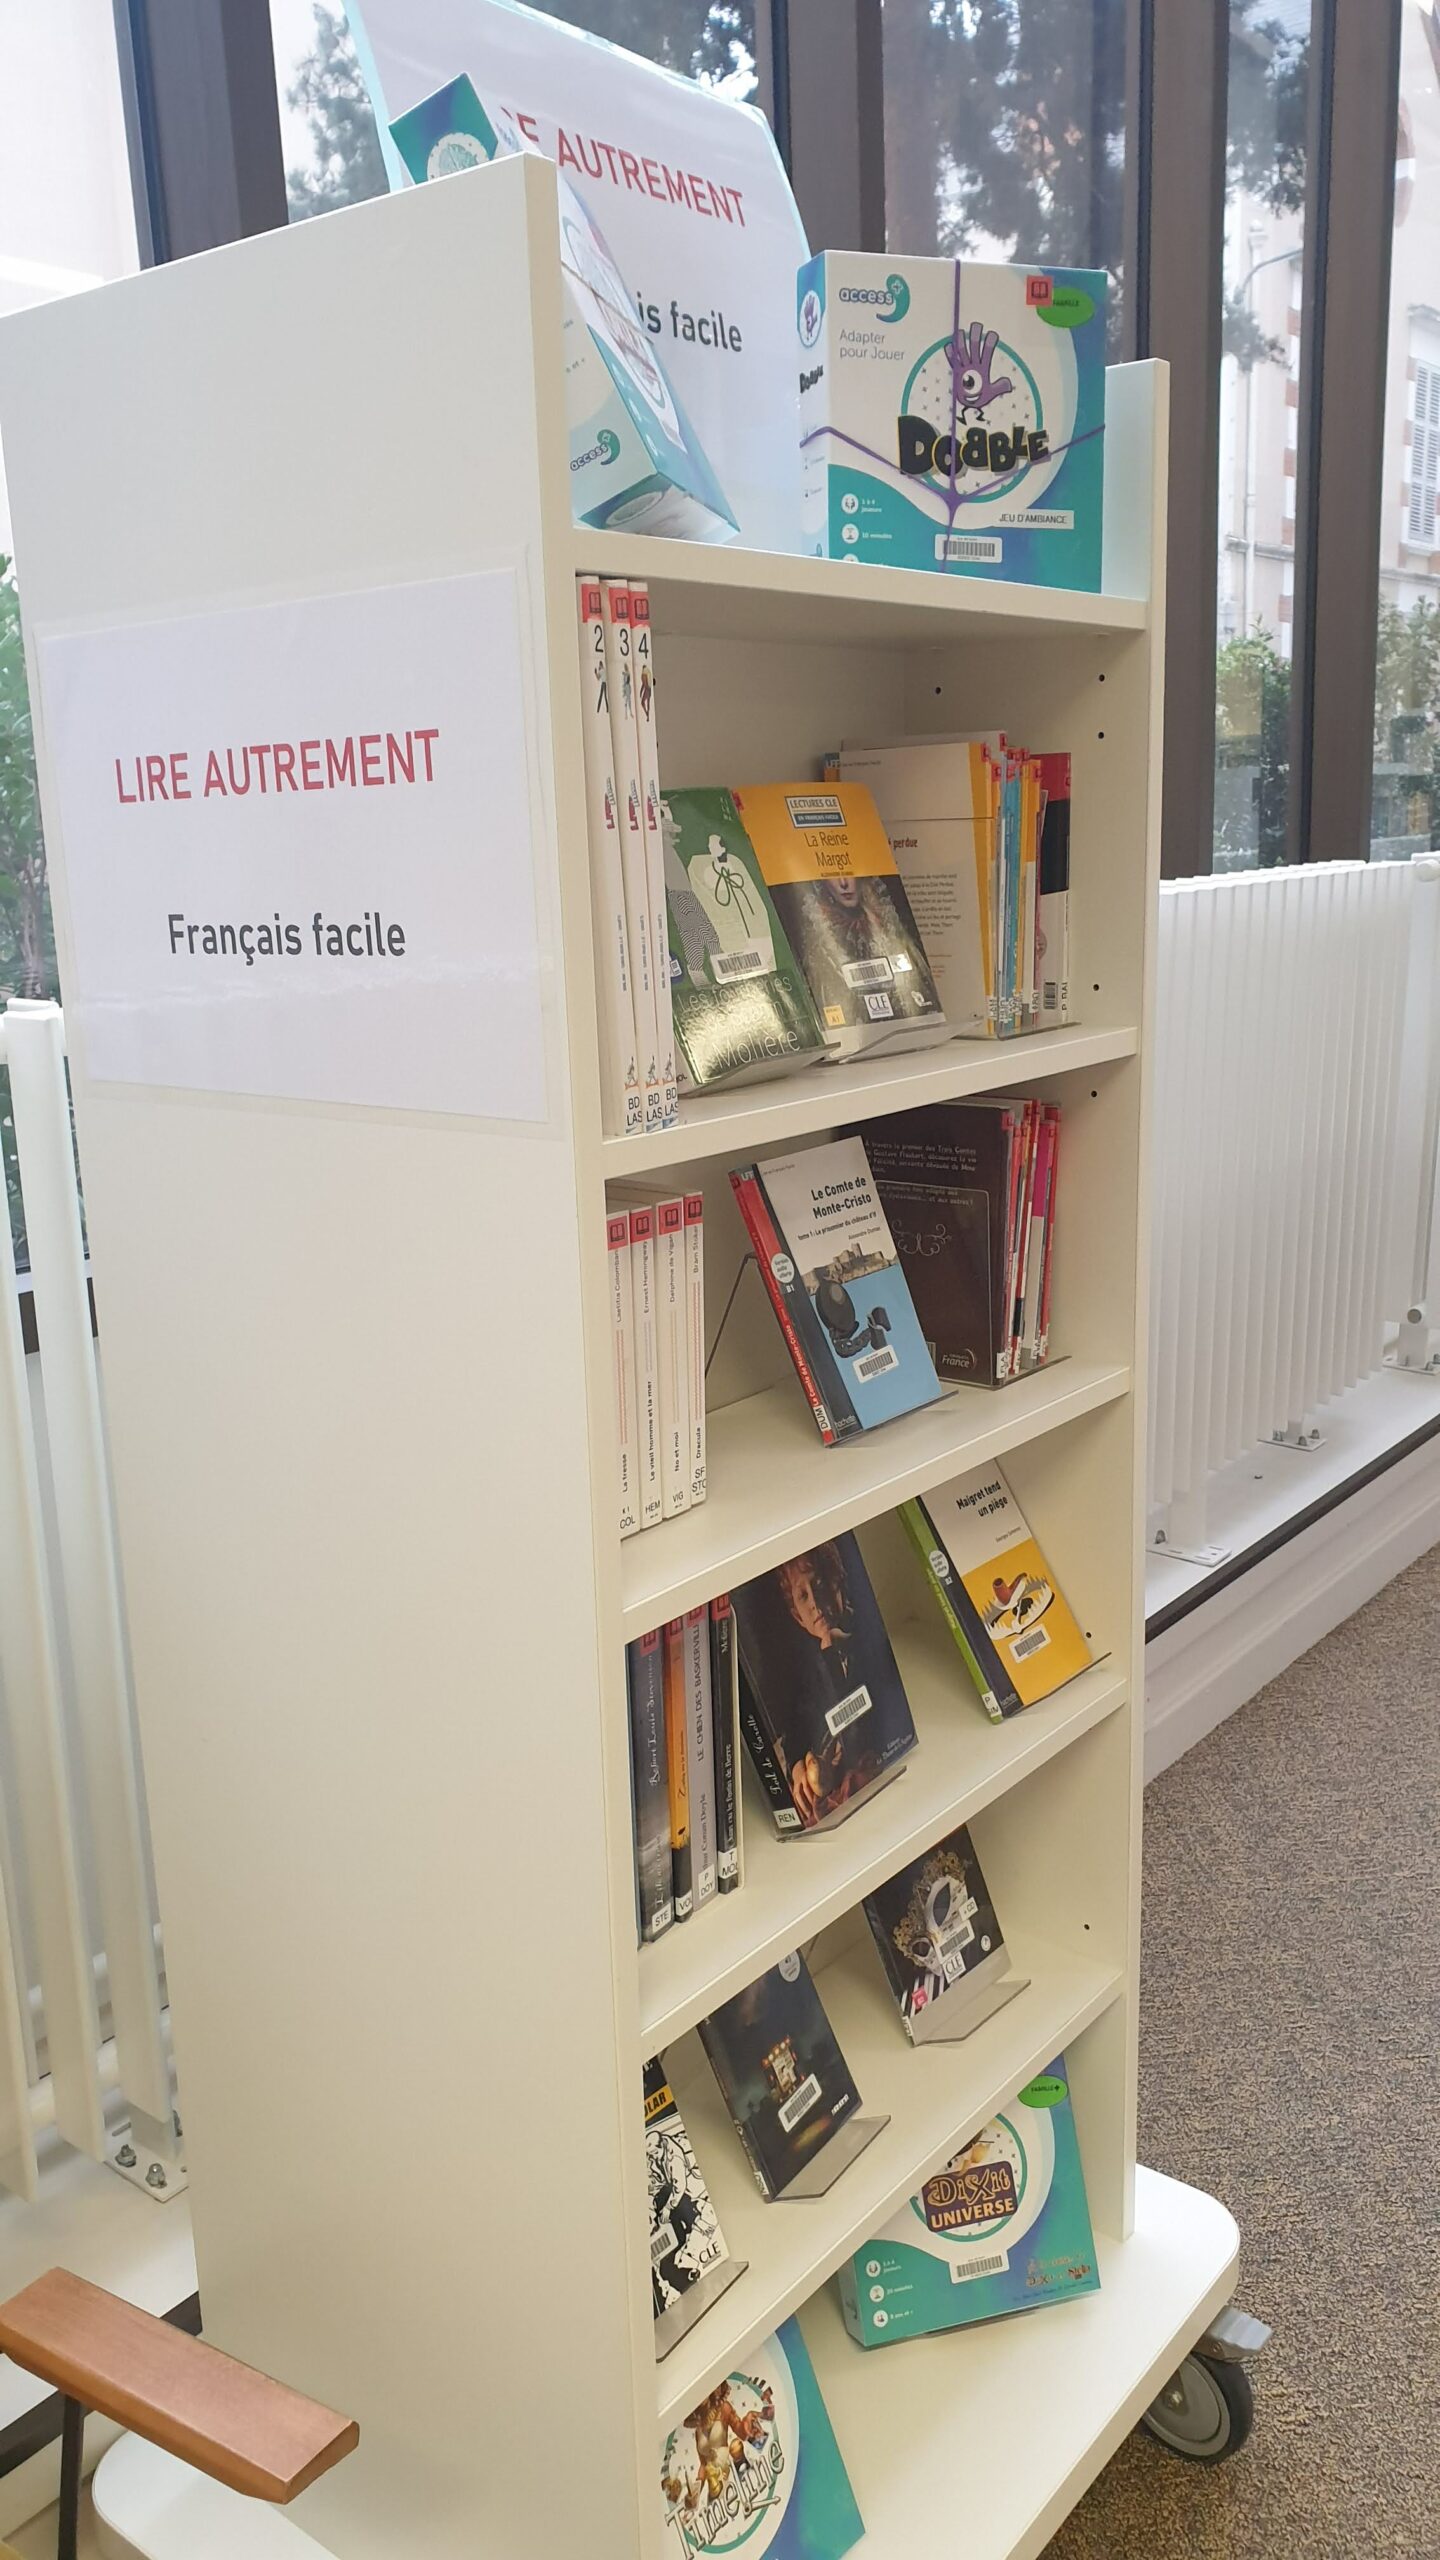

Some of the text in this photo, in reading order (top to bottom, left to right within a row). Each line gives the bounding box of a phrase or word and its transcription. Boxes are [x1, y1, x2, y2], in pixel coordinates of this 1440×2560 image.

[558, 128, 747, 227] AUTREMENT
[670, 302, 743, 353] facile
[839, 329, 885, 345] Adapter
[840, 346, 905, 360] pour Jouer
[999, 513, 1067, 524] JEU D'AMBIANCE
[594, 624, 604, 653] 2
[619, 628, 630, 656] 3
[638, 633, 649, 659] 4
[115, 729, 439, 803] LIRE AUTREMENT
[804, 831, 849, 847] La Reine
[893, 838, 918, 850] perdue
[815, 852, 852, 870] Margot
[168, 912, 406, 966] Français facile
[712, 1029, 800, 1069] Molière
[648, 1093, 660, 1106] BD
[666, 1087, 676, 1100] BD
[628, 1096, 639, 1110] BD
[665, 1101, 679, 1116] LAS
[627, 1111, 642, 1126] LAS
[646, 1107, 662, 1122] LAS
[811, 1176, 867, 1201] Le Comte de
[813, 1193, 872, 1219] Monte-Cristo
[942, 1354, 970, 1368] France
[815, 1406, 828, 1430] DUM
[695, 1466, 706, 1479] SF
[673, 1491, 684, 1502] VIG
[956, 1480, 1001, 1510] Maigret tend
[645, 1500, 660, 1514] HEM
[978, 1496, 1008, 1517] un piège
[620, 1515, 636, 1529] COL
[695, 1691, 703, 1711] DES
[697, 1747, 704, 1761] LE
[778, 1813, 795, 1823] REN
[729, 1851, 734, 1861] T
[705, 1872, 709, 1881] P
[701, 1881, 713, 1896] DOY
[655, 1910, 668, 1926] STE
[946, 1955, 962, 1974] CLE
[930, 2198, 1014, 2228] UNIVERSE
[699, 2241, 719, 2263] CLE
